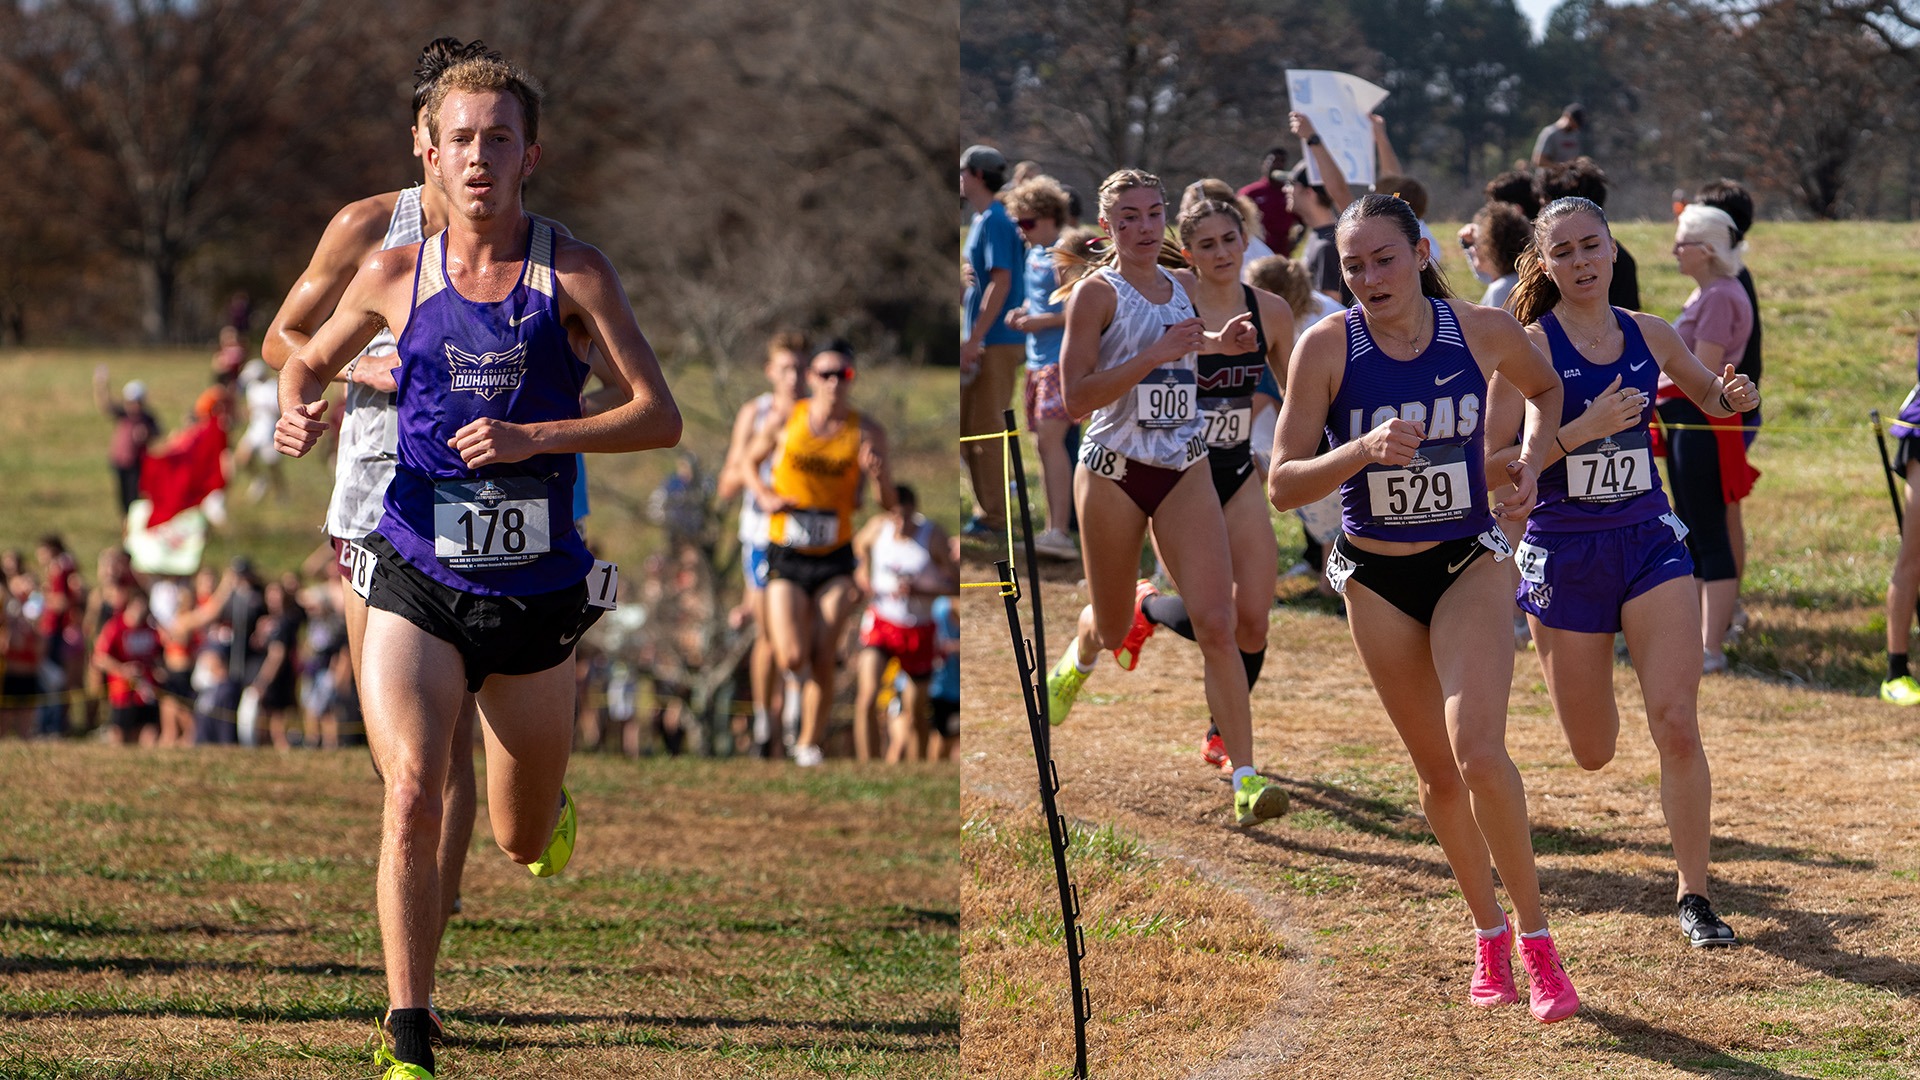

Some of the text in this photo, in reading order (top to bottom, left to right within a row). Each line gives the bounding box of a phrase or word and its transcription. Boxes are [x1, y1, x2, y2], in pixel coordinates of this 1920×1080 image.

[455, 373, 519, 387] DUHAWKS
[1197, 364, 1265, 390] MIT
[1563, 368, 1581, 378] UAA
[1150, 389, 1188, 419] 908
[1203, 415, 1239, 442] 729
[1582, 456, 1637, 495] 742
[1387, 472, 1453, 515] 529
[457, 508, 526, 556] 178
